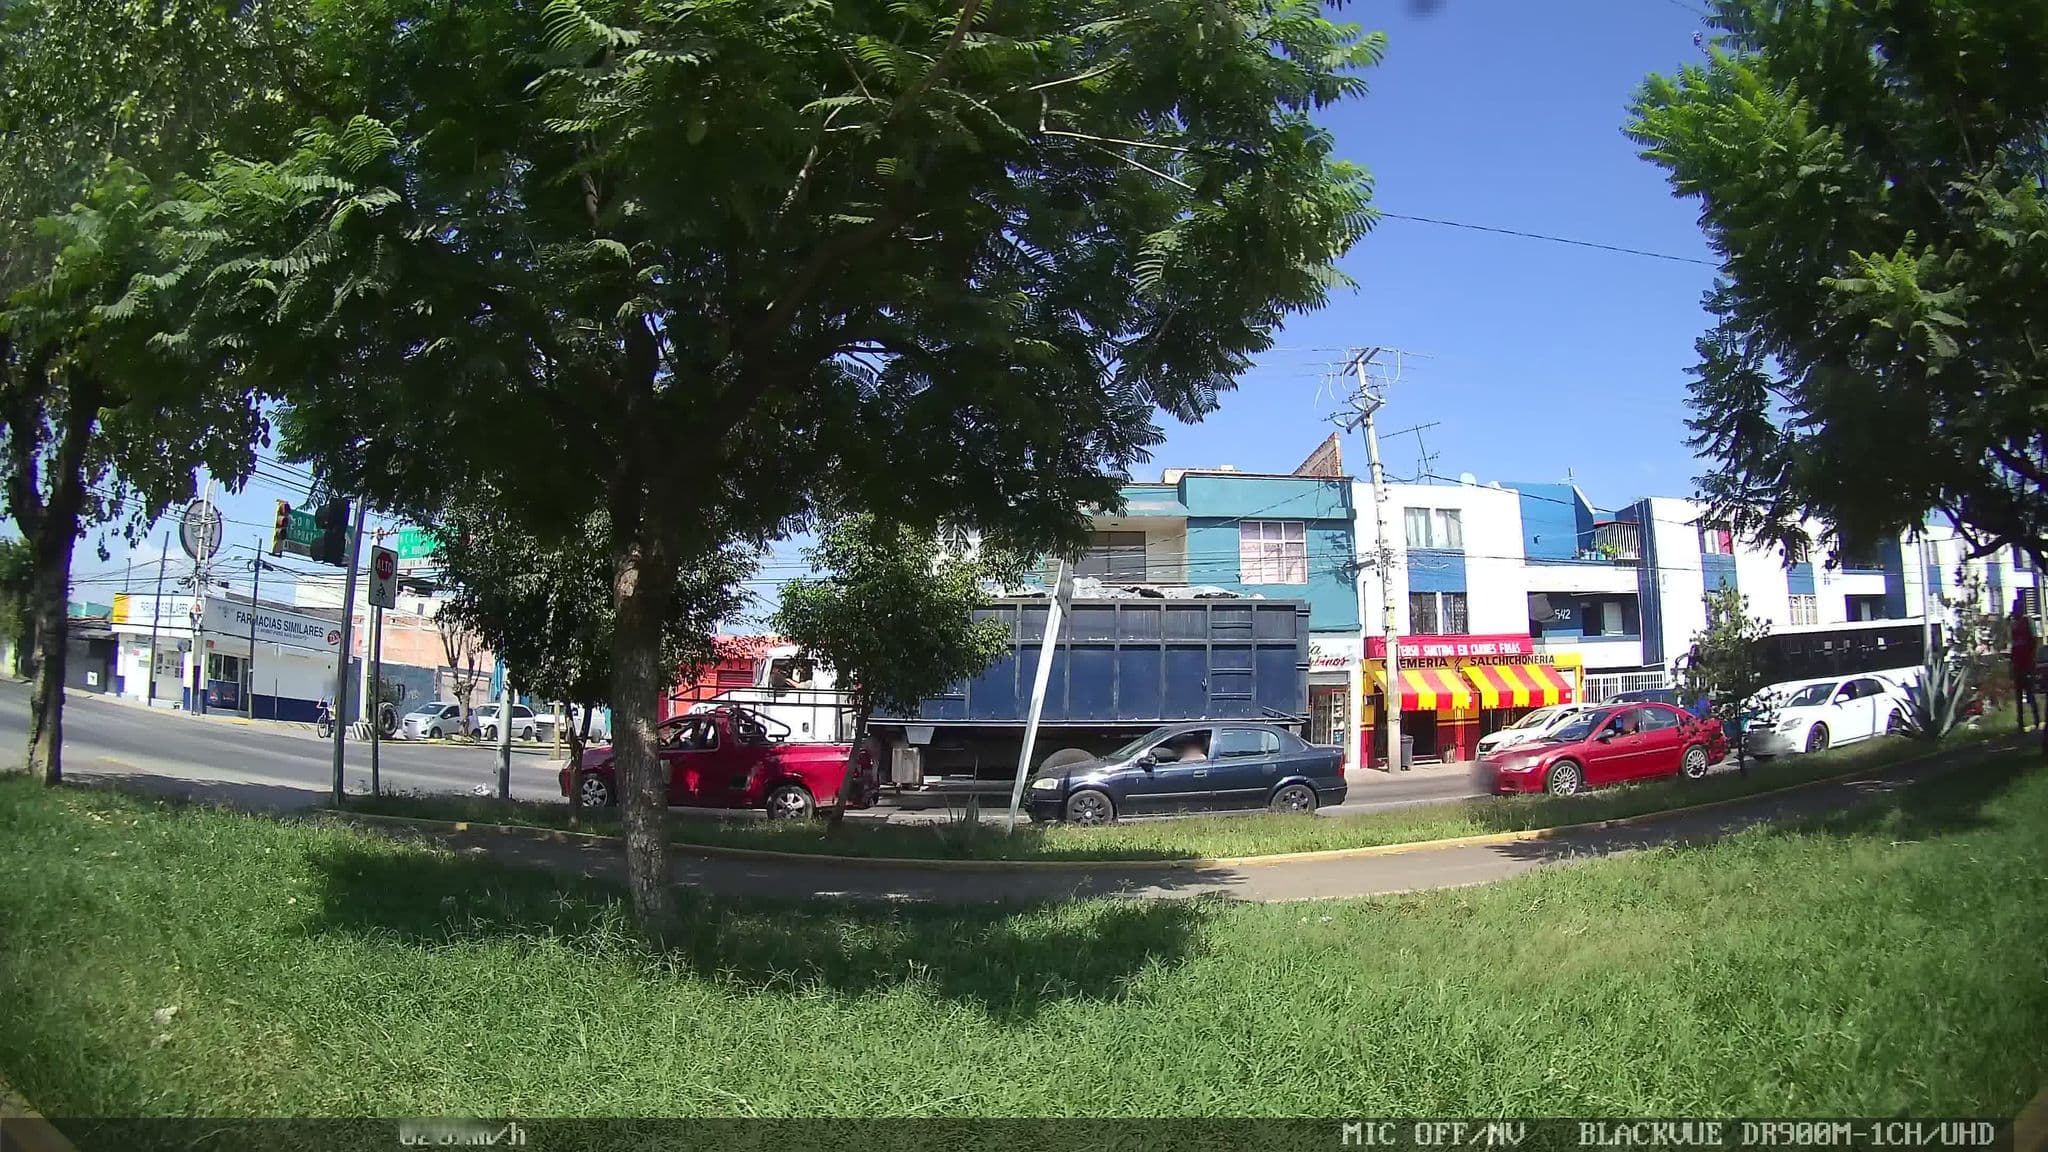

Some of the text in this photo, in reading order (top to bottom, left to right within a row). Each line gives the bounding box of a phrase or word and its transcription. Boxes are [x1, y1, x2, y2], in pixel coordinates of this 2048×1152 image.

[377, 559, 393, 574] ALTO
[283, 619, 324, 637] SIMILARES
[1381, 656, 1449, 670] CEMERIA
[1470, 654, 1556, 667] SALCHICHONERIA
